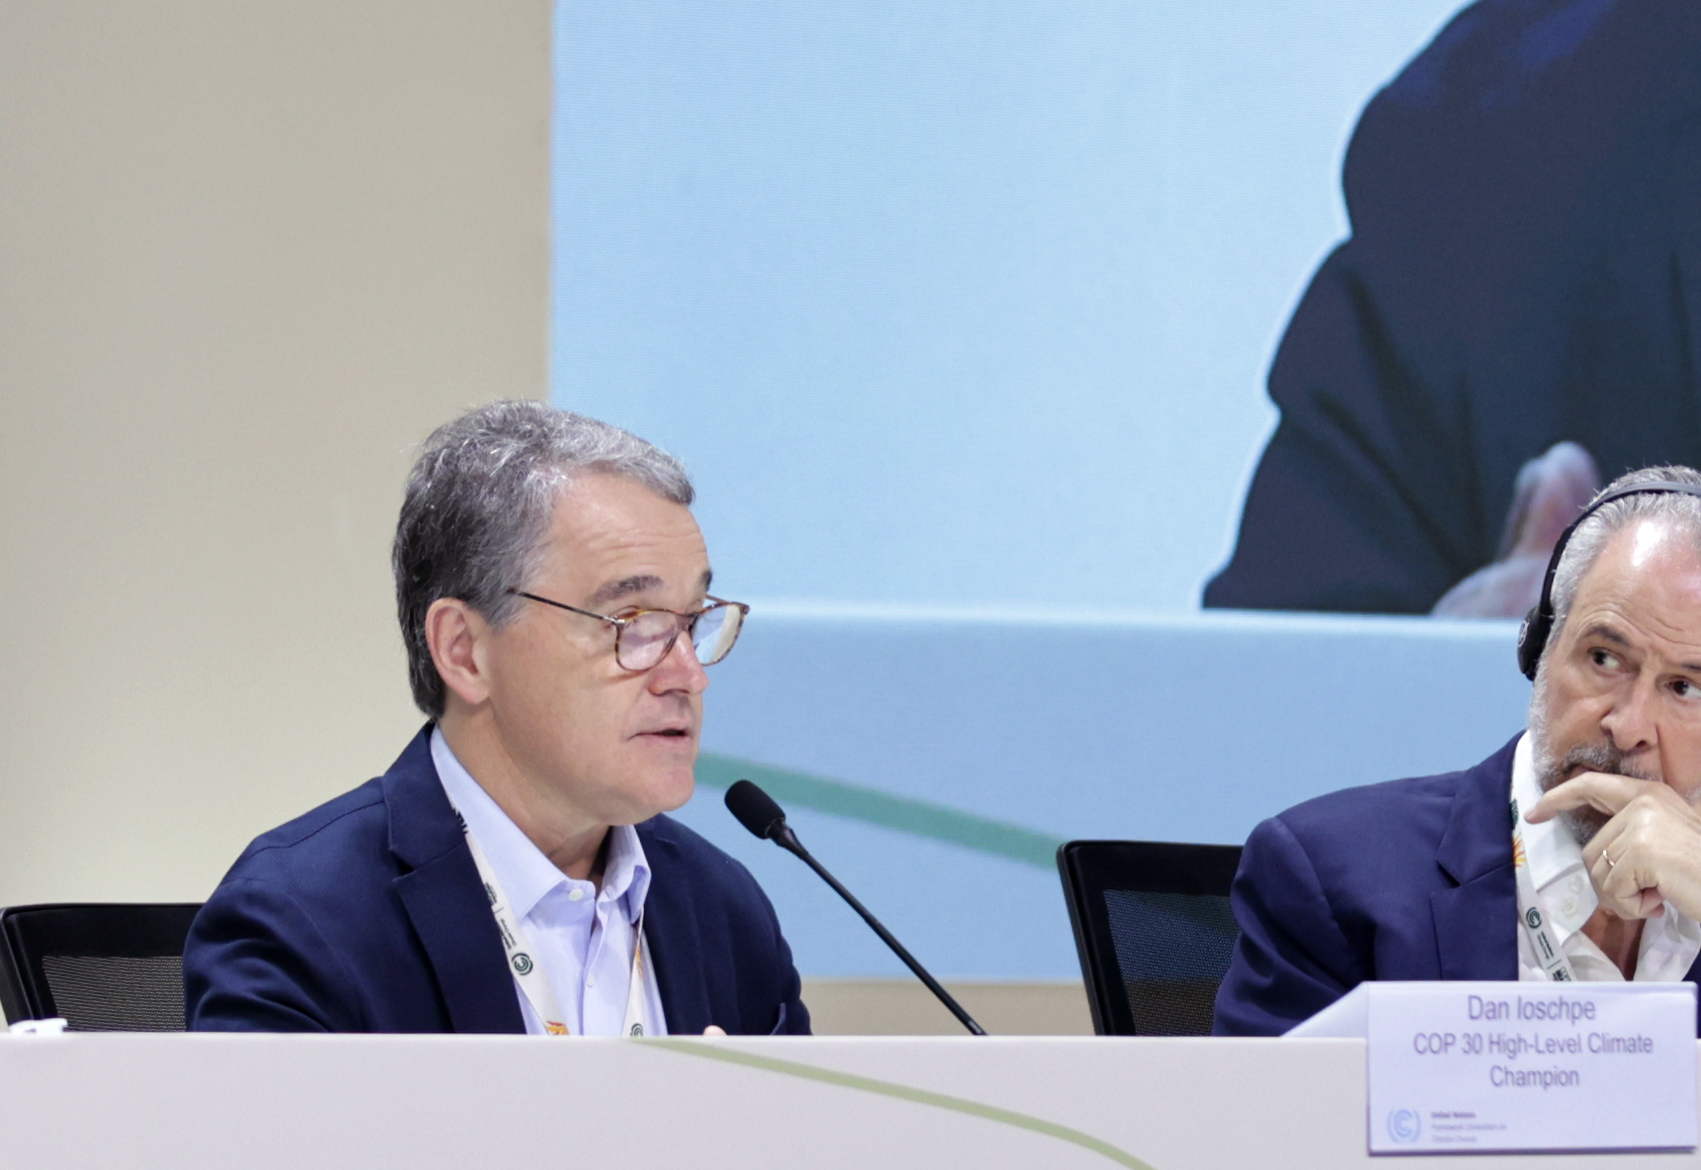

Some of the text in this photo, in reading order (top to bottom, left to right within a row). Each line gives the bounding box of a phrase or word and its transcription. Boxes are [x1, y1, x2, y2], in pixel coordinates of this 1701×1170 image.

[1467, 994, 1597, 1026] Dan Ioschpe
[1412, 1032, 1655, 1061] COP 30 High-Level Climate
[1489, 1064, 1581, 1091] Champion
